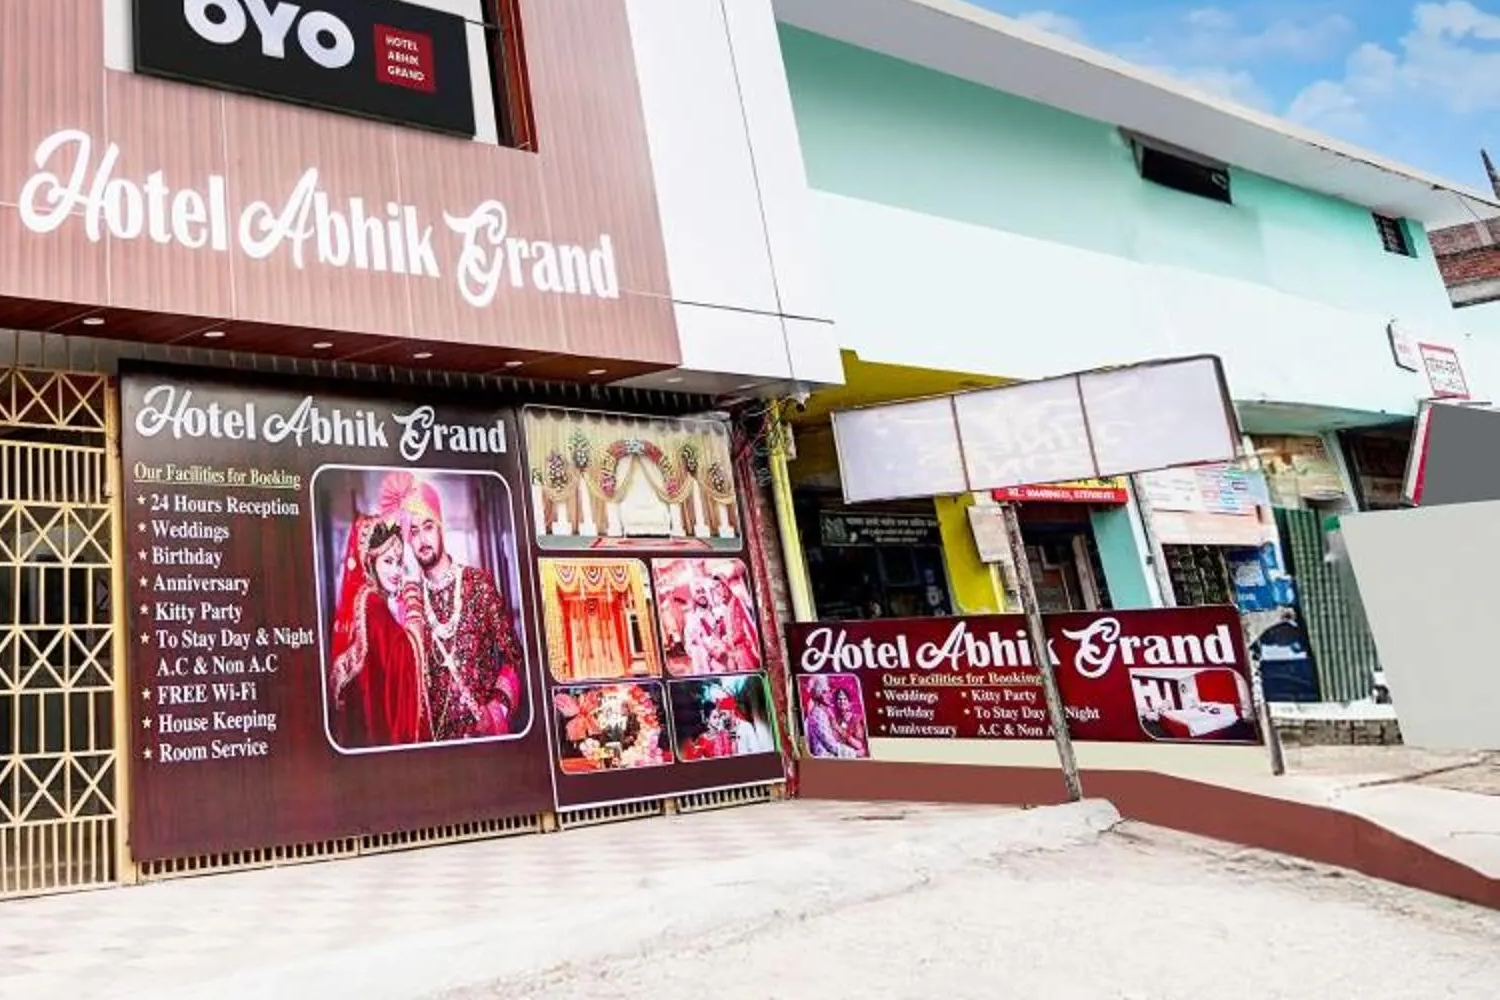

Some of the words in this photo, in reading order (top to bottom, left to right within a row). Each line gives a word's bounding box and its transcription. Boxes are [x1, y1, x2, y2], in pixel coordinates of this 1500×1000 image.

[385, 34, 418, 51] HOTEL
[388, 51, 418, 66] ABHIK
[387, 66, 424, 81] GRAND
[18, 128, 229, 251] Hotel
[238, 167, 440, 278] Abhik
[444, 200, 620, 308] Grand
[135, 385, 256, 440] Hotel
[262, 395, 389, 448] Abhik
[392, 405, 506, 460] Grand
[134, 461, 162, 481] Our
[166, 464, 225, 483] Facilities
[227, 467, 247, 485] for
[250, 469, 300, 490] Booking
[151, 493, 169, 511] 24
[174, 495, 222, 512] Hours
[226, 496, 299, 518] Reception
[151, 520, 229, 542] Weddings
[152, 545, 223, 568] Birthday
[153, 573, 250, 595] Anniversary
[155, 602, 196, 624] Kitty
[200, 602, 242, 624] Party
[156, 630, 178, 648] To
[182, 629, 216, 650] Stay
[221, 629, 251, 650] Day
[255, 628, 269, 646] &
[273, 627, 314, 648] Night
[800, 628, 910, 676] Hotel
[1061, 617, 1236, 679] Grand
[156, 657, 188, 677] A.C
[193, 656, 208, 675] &
[213, 656, 245, 674] Non
[249, 654, 278, 673] A.C
[882, 674, 907, 685] Our
[910, 673, 963, 685] Facilities
[966, 673, 984, 685] for
[988, 671, 1043, 687] Booking
[157, 684, 208, 705] FREE
[212, 681, 257, 702] Wi-Fi
[884, 689, 938, 703] Weddings
[971, 688, 1000, 705] Kitty
[1004, 687, 1036, 704] Party
[158, 714, 208, 733] House
[212, 710, 277, 732] Keeping
[886, 706, 934, 720] Birthday
[974, 707, 991, 719] To
[994, 706, 1018, 721] Stay
[1022, 706, 1046, 721] Day
[1064, 705, 1100, 722] Night
[889, 723, 957, 738] Anniversary
[977, 724, 1000, 737] A.C
[1003, 723, 1015, 737] &
[1017, 723, 1043, 737] Non
[159, 743, 207, 763] Room
[211, 738, 268, 758] Service
